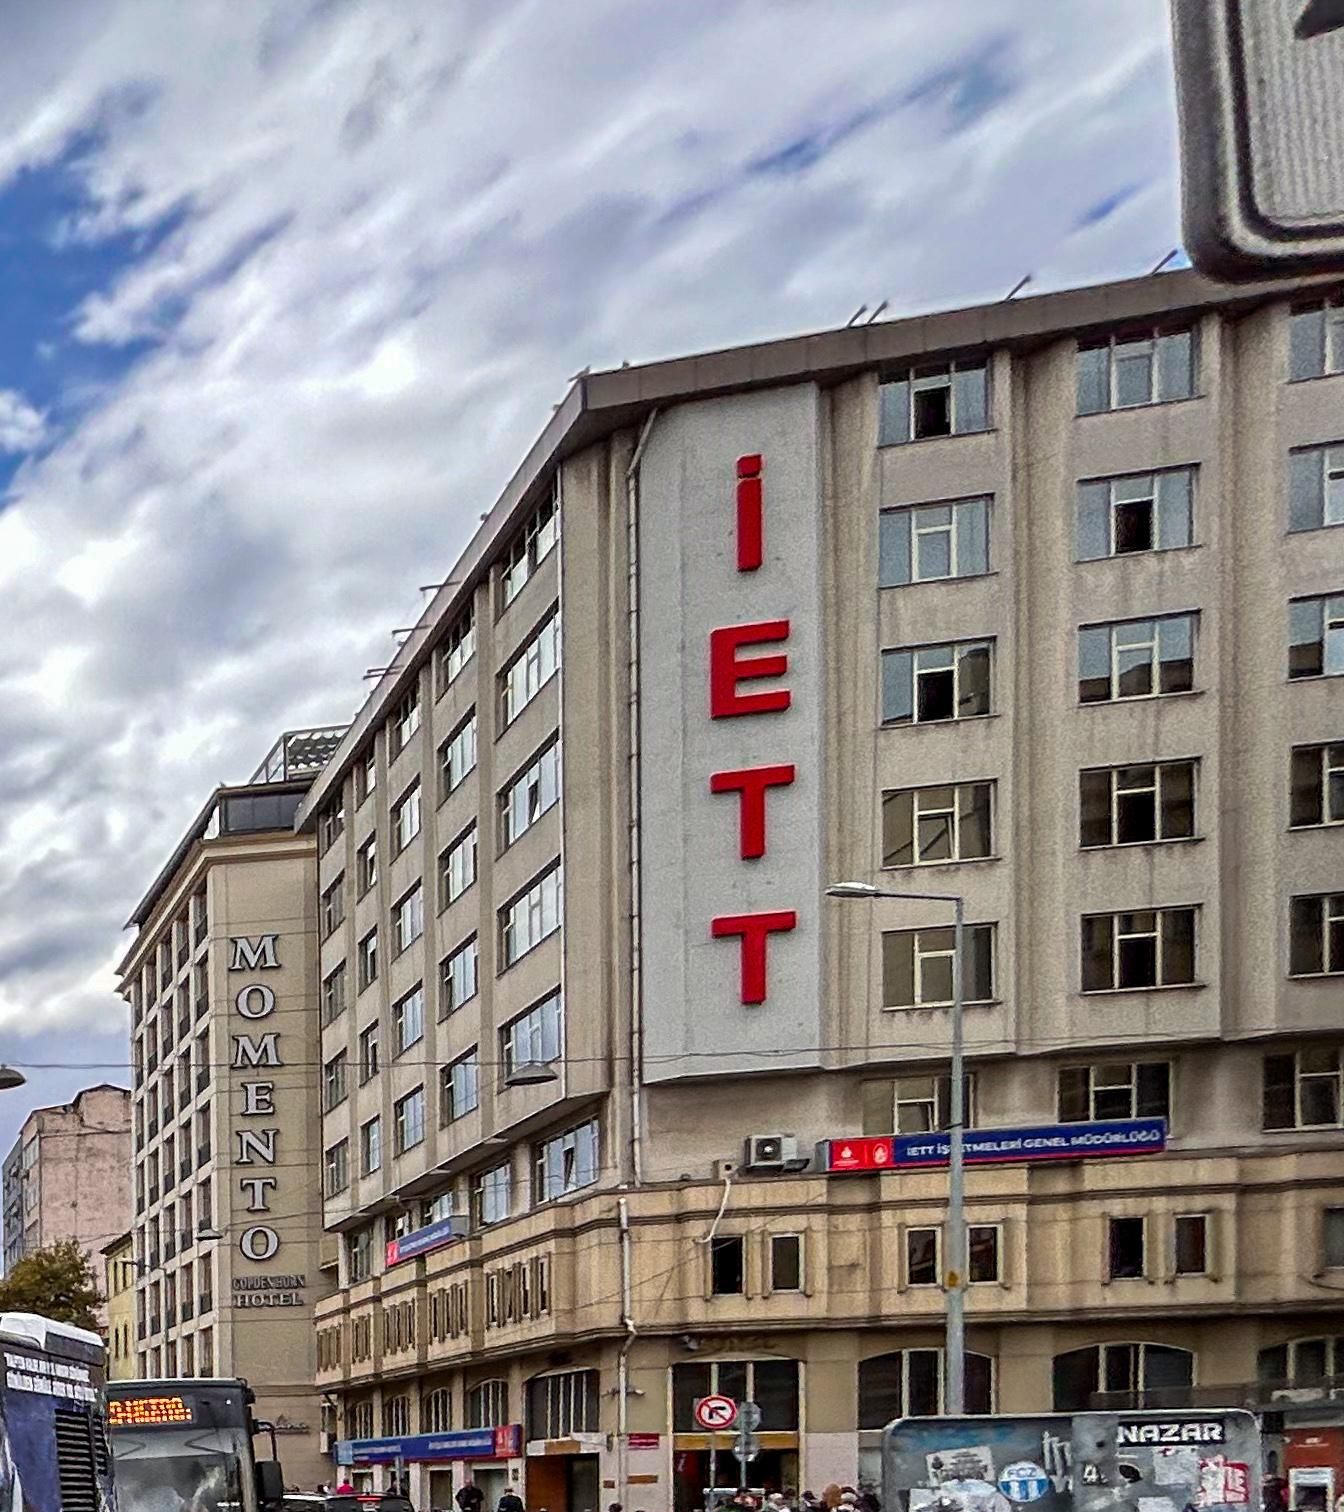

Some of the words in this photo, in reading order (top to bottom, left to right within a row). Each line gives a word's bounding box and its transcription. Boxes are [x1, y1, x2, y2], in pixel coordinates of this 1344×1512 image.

[710, 452, 797, 1006] İETT
[228, 934, 283, 1262] MOMENTO
[1023, 1137, 1070, 1149] GENEL
[235, 1292, 304, 1308] HOTEL
[1116, 1422, 1223, 1443] NAZAR
